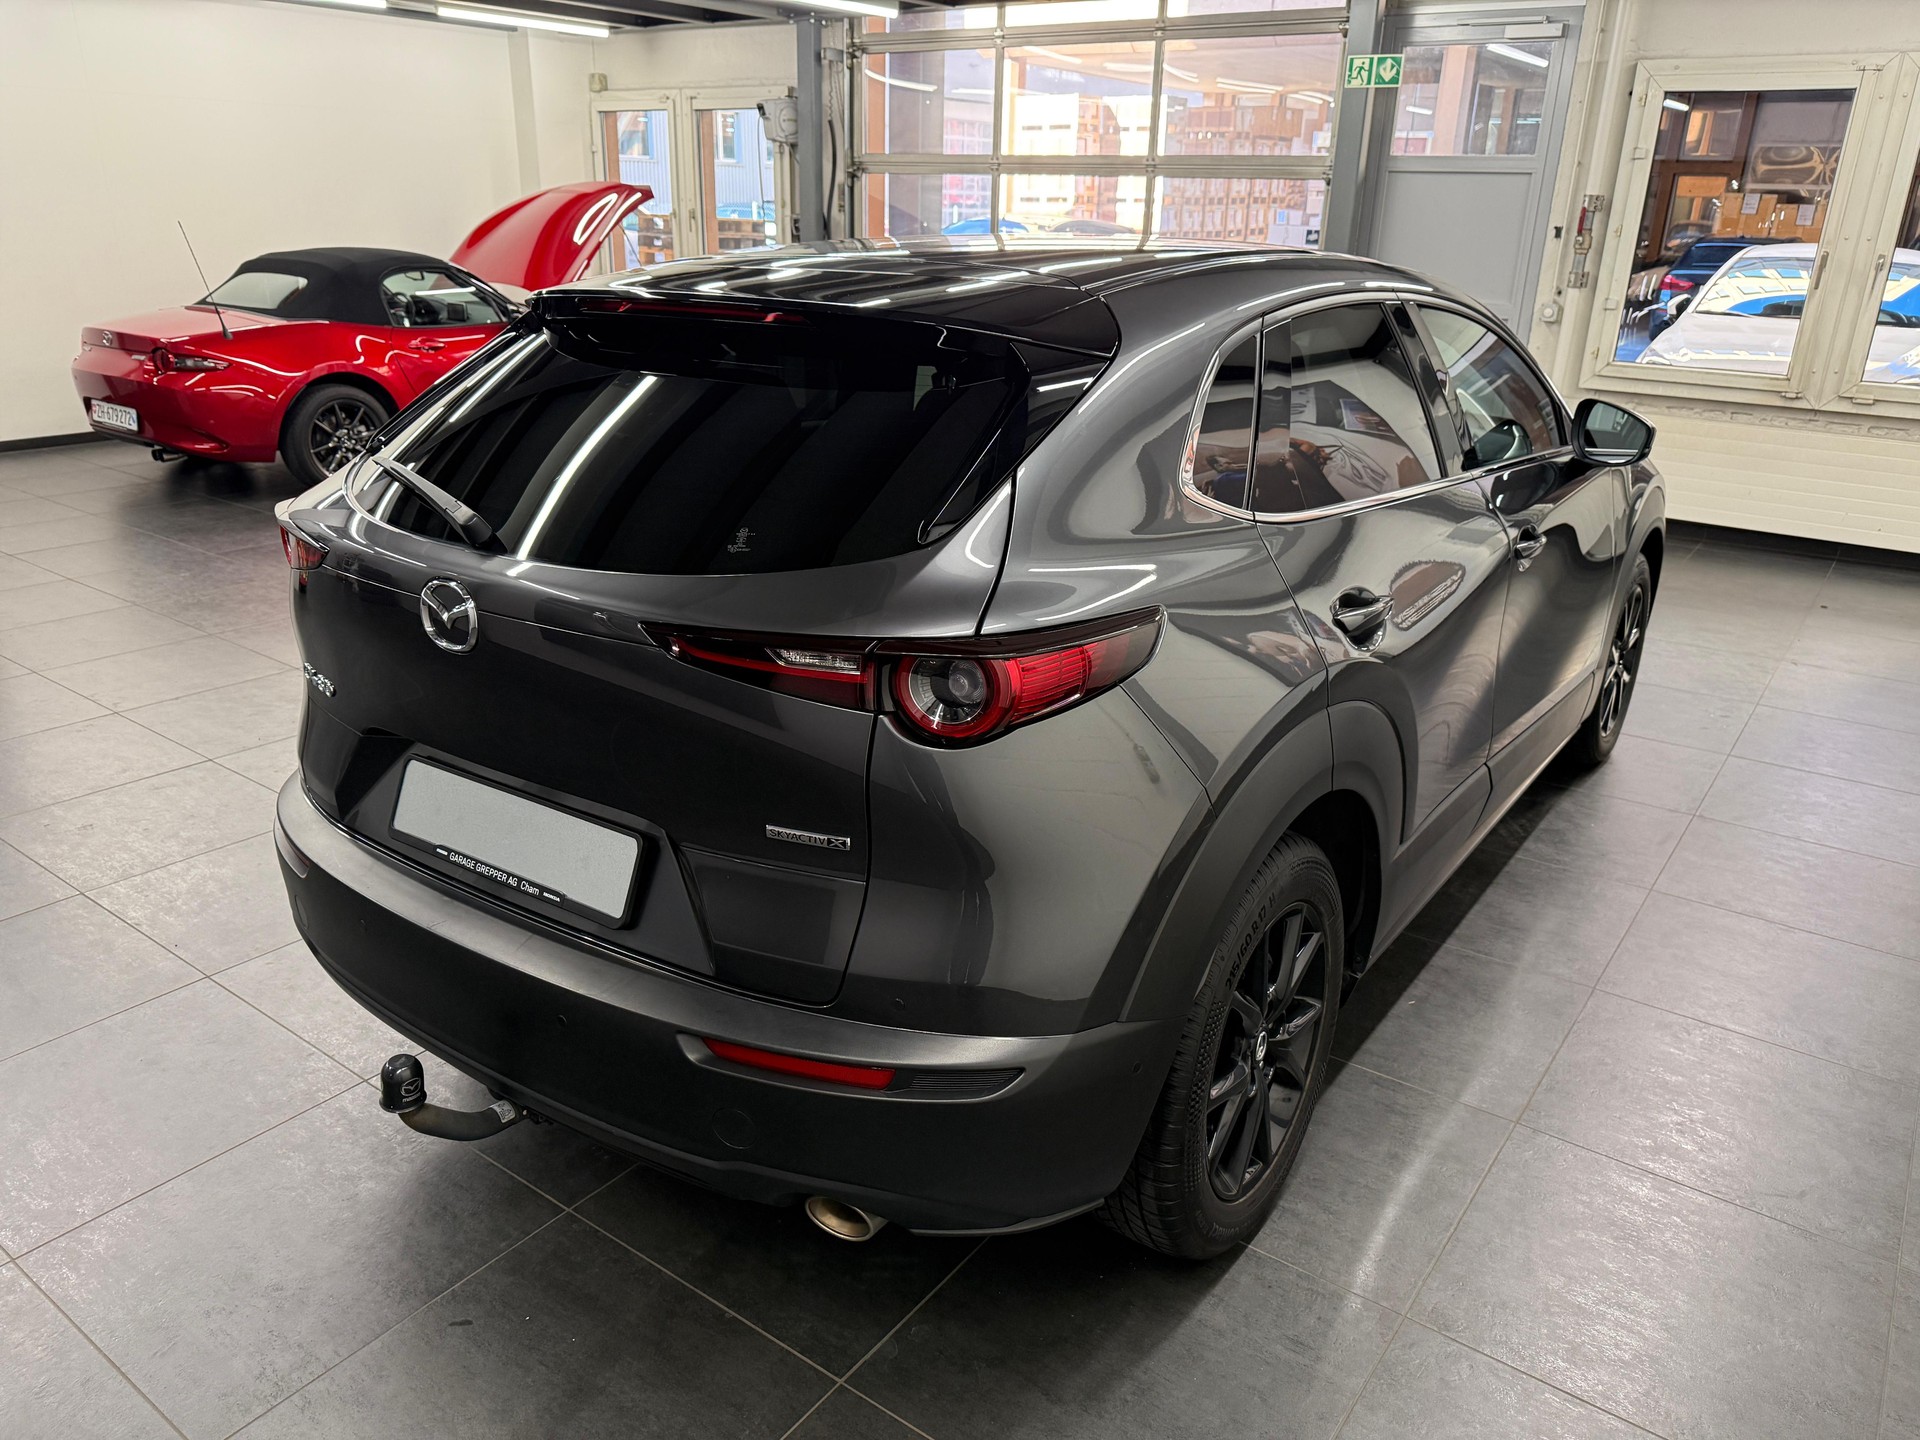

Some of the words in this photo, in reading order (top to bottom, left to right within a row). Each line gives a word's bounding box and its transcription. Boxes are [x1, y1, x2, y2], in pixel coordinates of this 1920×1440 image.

[769, 828, 826, 845] SKYACTIV
[449, 851, 476, 870] GARAGE
[475, 863, 508, 883] GREPPER
[507, 876, 518, 887] AG
[520, 880, 540, 896] Cham
[1225, 933, 1252, 991] 215/60
